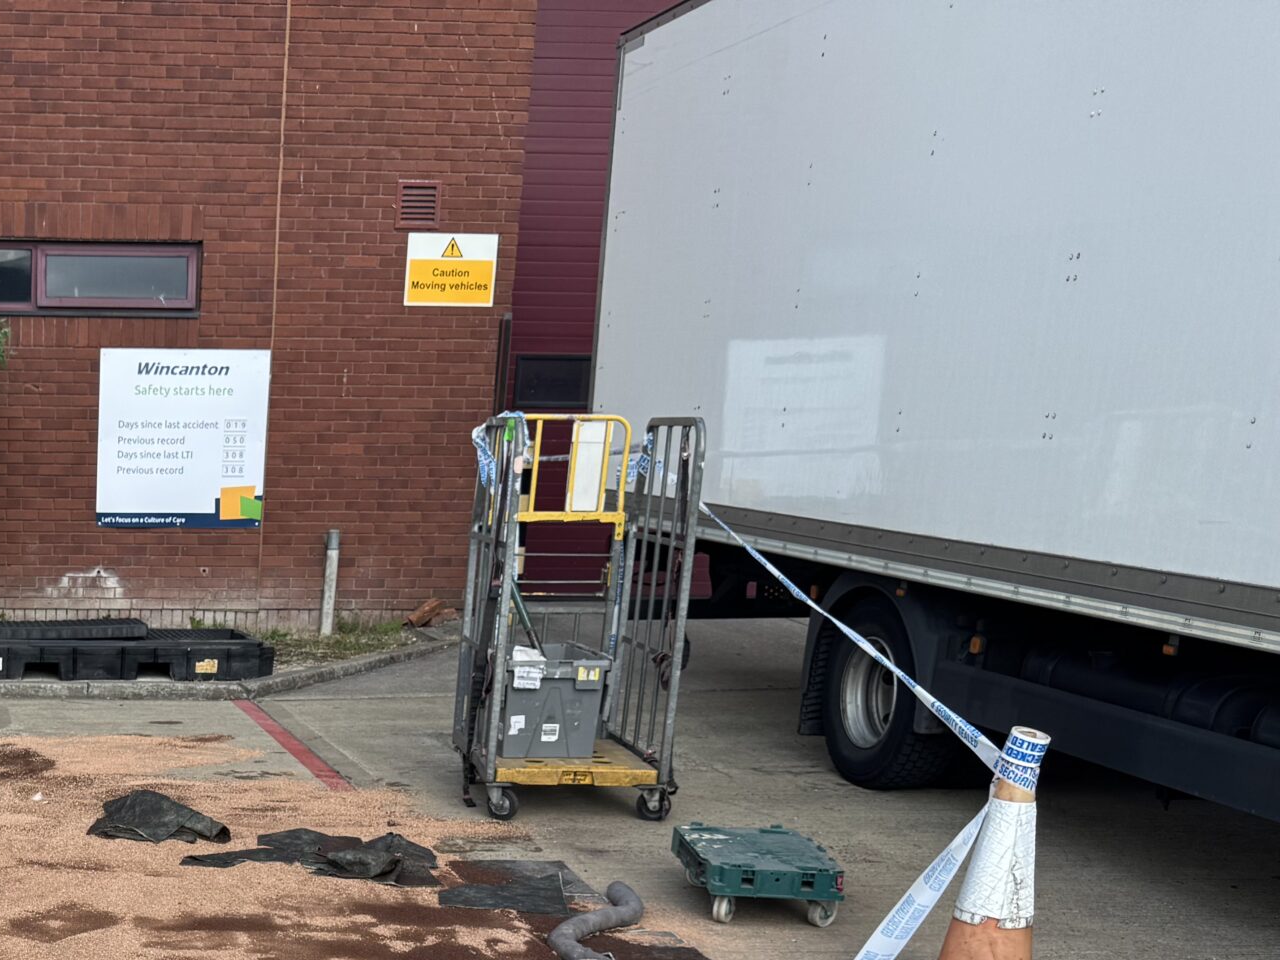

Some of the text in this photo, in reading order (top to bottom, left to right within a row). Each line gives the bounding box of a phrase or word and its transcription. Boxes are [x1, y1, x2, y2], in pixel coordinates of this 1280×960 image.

[432, 268, 470, 278] Caution
[411, 281, 488, 292] Moving vehicles
[137, 361, 230, 377] Wincanton
[134, 384, 234, 398] Safety starts here
[118, 420, 139, 431] Days
[141, 419, 162, 429] since
[165, 420, 180, 429] last
[182, 420, 219, 430] accident
[117, 435, 155, 445] Previous
[157, 435, 185, 445] record
[117, 450, 138, 461] Days
[139, 450, 162, 460] since
[163, 450, 179, 460] last
[181, 450, 193, 460] LTI
[116, 465, 154, 475] Previous
[155, 465, 184, 475] record
[958, 726, 979, 748] SEALED
[1006, 746, 1042, 764] ECKED
[998, 763, 1036, 791] SECURIT
